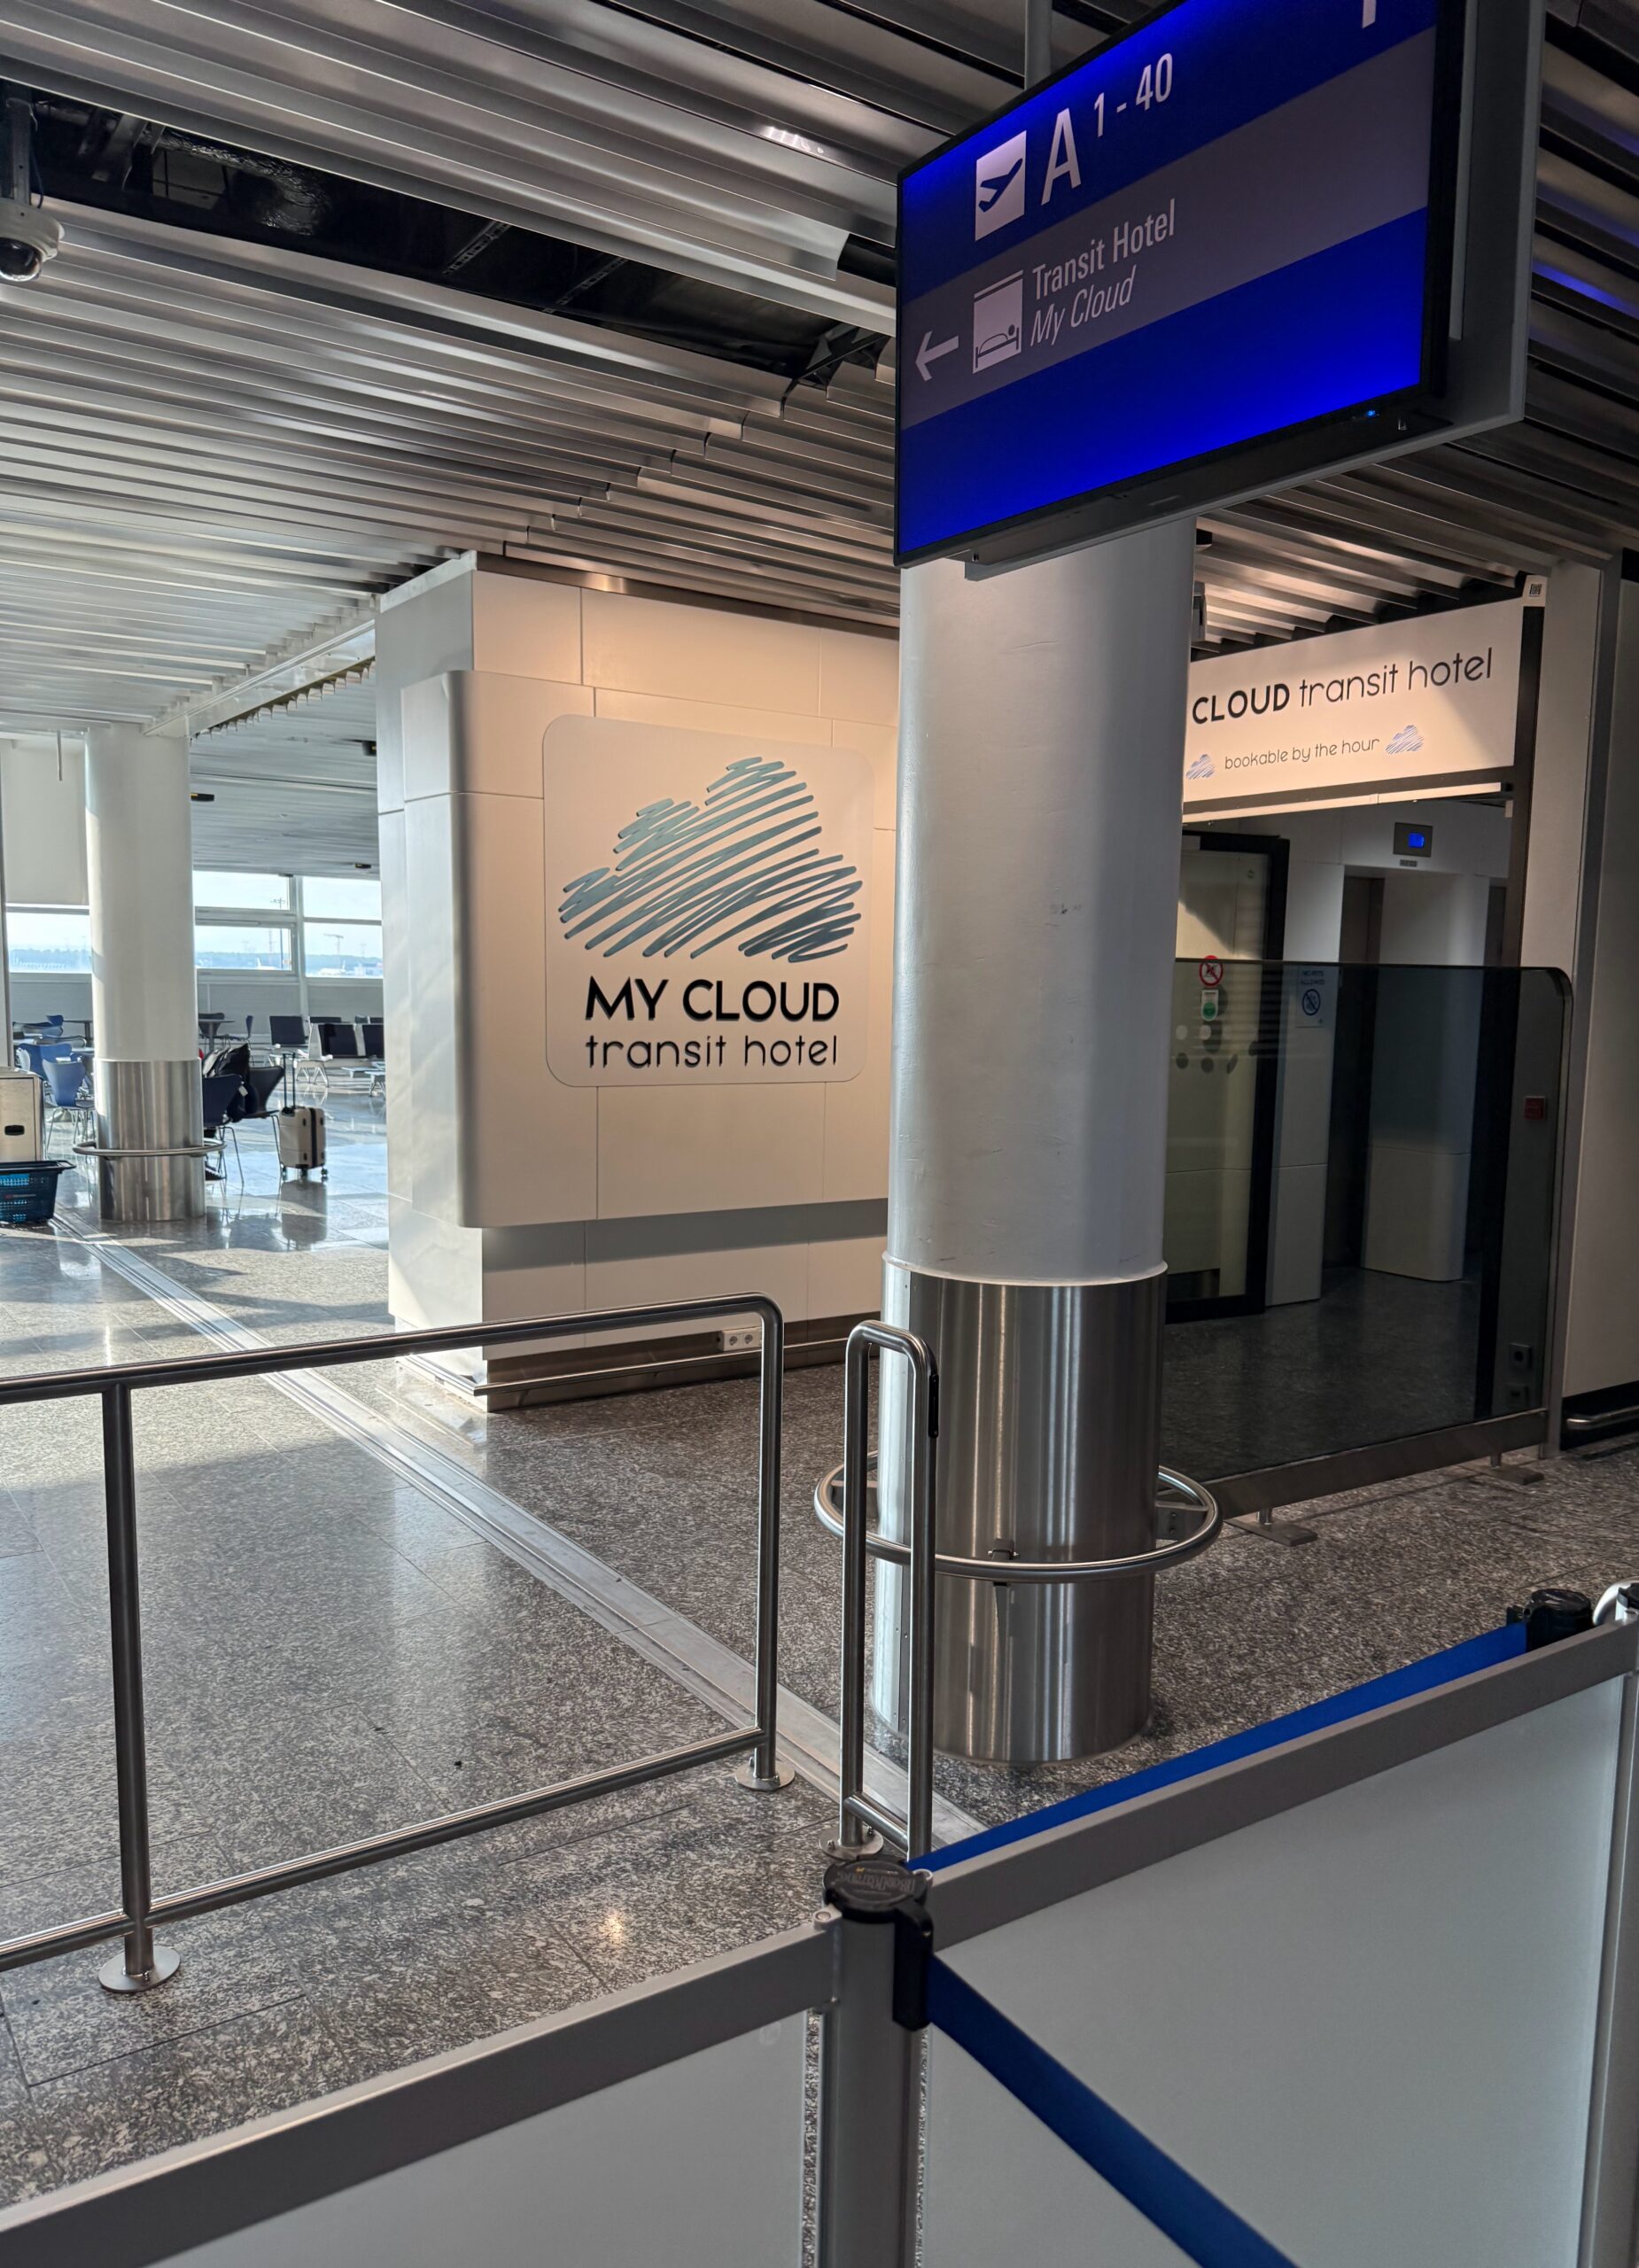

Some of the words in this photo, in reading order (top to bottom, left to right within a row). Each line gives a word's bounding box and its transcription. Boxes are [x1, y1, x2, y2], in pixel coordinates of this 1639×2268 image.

[1041, 107, 1081, 206] A
[1094, 92, 1105, 137] 1
[1136, 52, 1173, 110] 40
[1032, 237, 1105, 300] Transit
[1113, 198, 1176, 263] Hotel
[1030, 303, 1065, 347] My
[1070, 264, 1137, 329] Cloud
[1192, 683, 1290, 725] CLOUD
[1299, 664, 1398, 707] transit
[1409, 647, 1493, 689] hotel
[1224, 748, 1288, 770] bookable
[1292, 746, 1311, 763] by
[1315, 743, 1337, 758] the
[1341, 739, 1380, 755] hour
[585, 975, 669, 1021] MY
[682, 978, 840, 1022] CLOUD
[585, 1035, 726, 1068] transit
[744, 1035, 837, 1067] hotel
